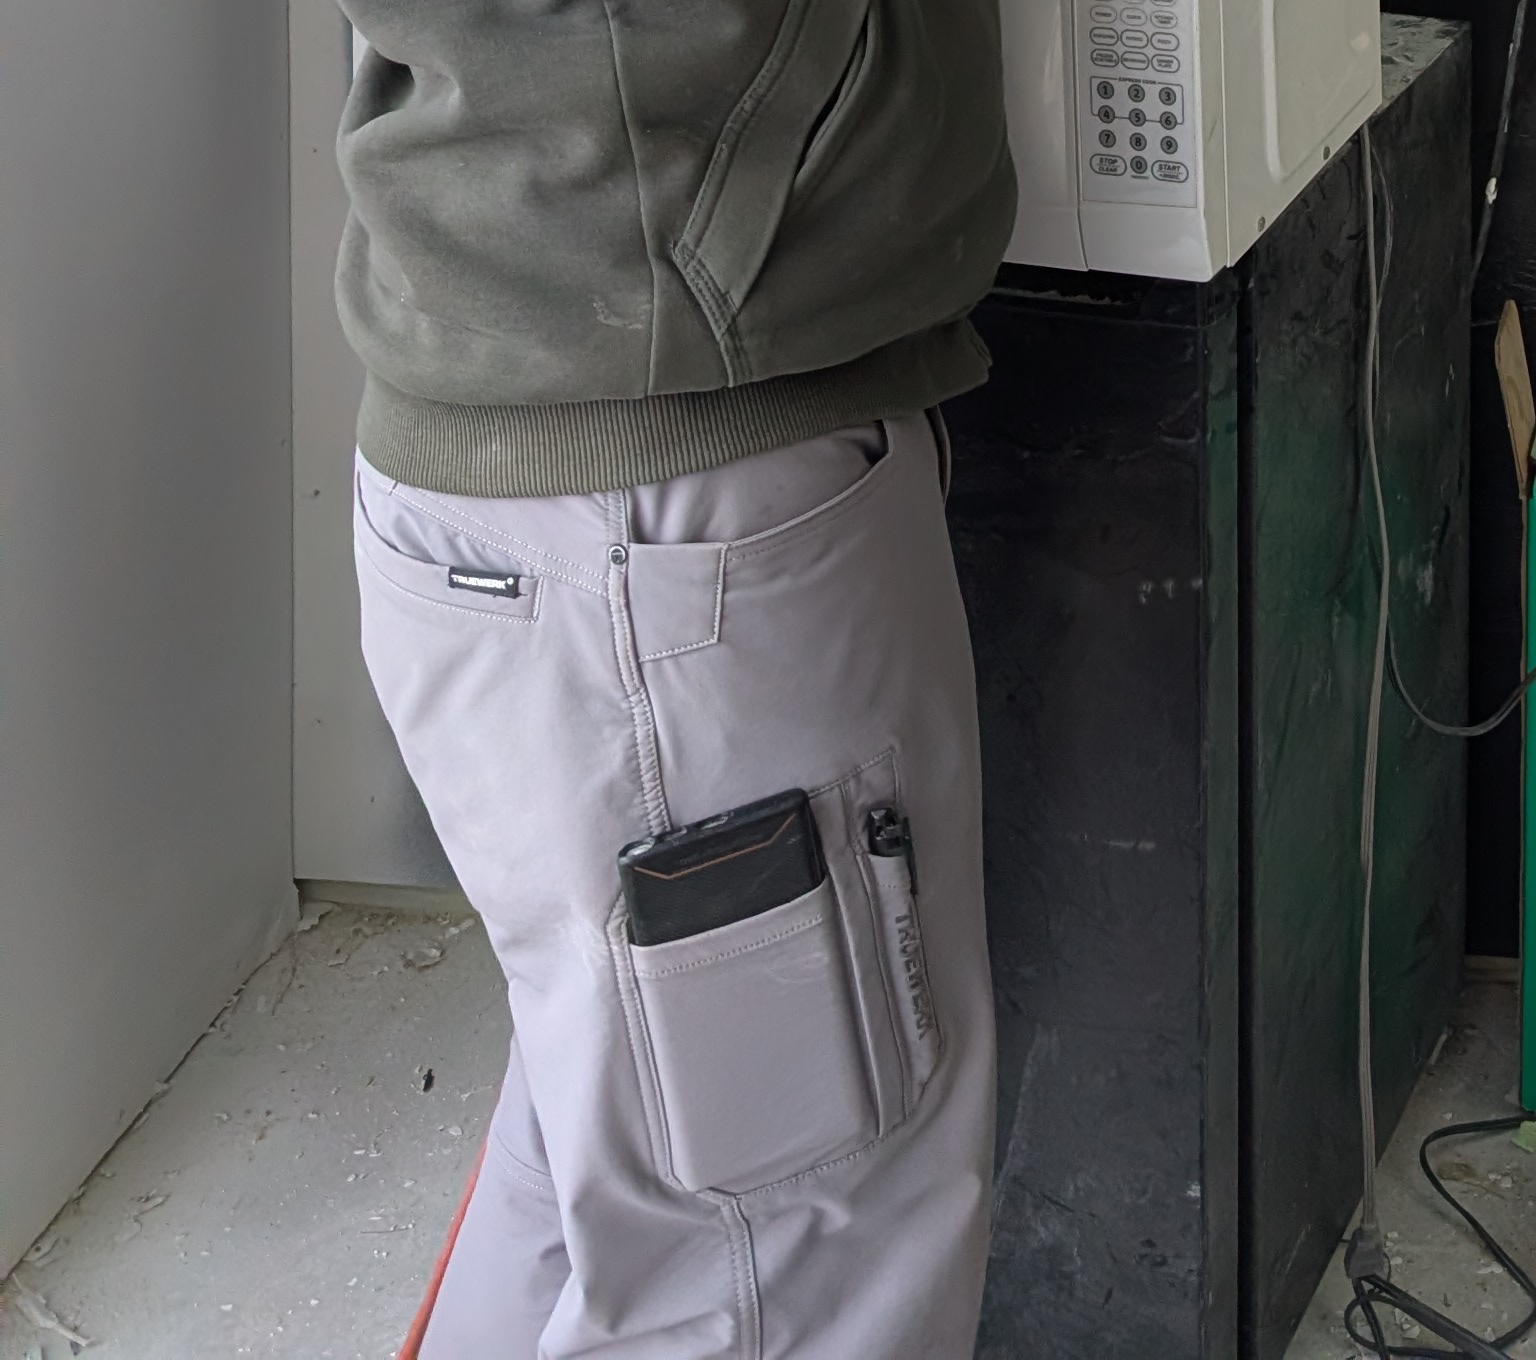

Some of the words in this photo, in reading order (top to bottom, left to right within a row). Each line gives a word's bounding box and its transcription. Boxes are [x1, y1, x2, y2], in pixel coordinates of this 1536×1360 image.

[1102, 85, 1108, 95] 1
[1134, 88, 1140, 98] 2
[1164, 91, 1171, 101] 3
[1103, 109, 1110, 119] 4
[1134, 112, 1141, 122] 5
[1165, 116, 1171, 126] 6
[1104, 133, 1111, 143] 7
[1134, 136, 1142, 147] 8
[1165, 140, 1172, 150] 9
[1099, 157, 1118, 165] STOP
[1135, 160, 1142, 170] 0
[1159, 163, 1182, 171] START
[450, 573, 507, 590] TRUEWERK
